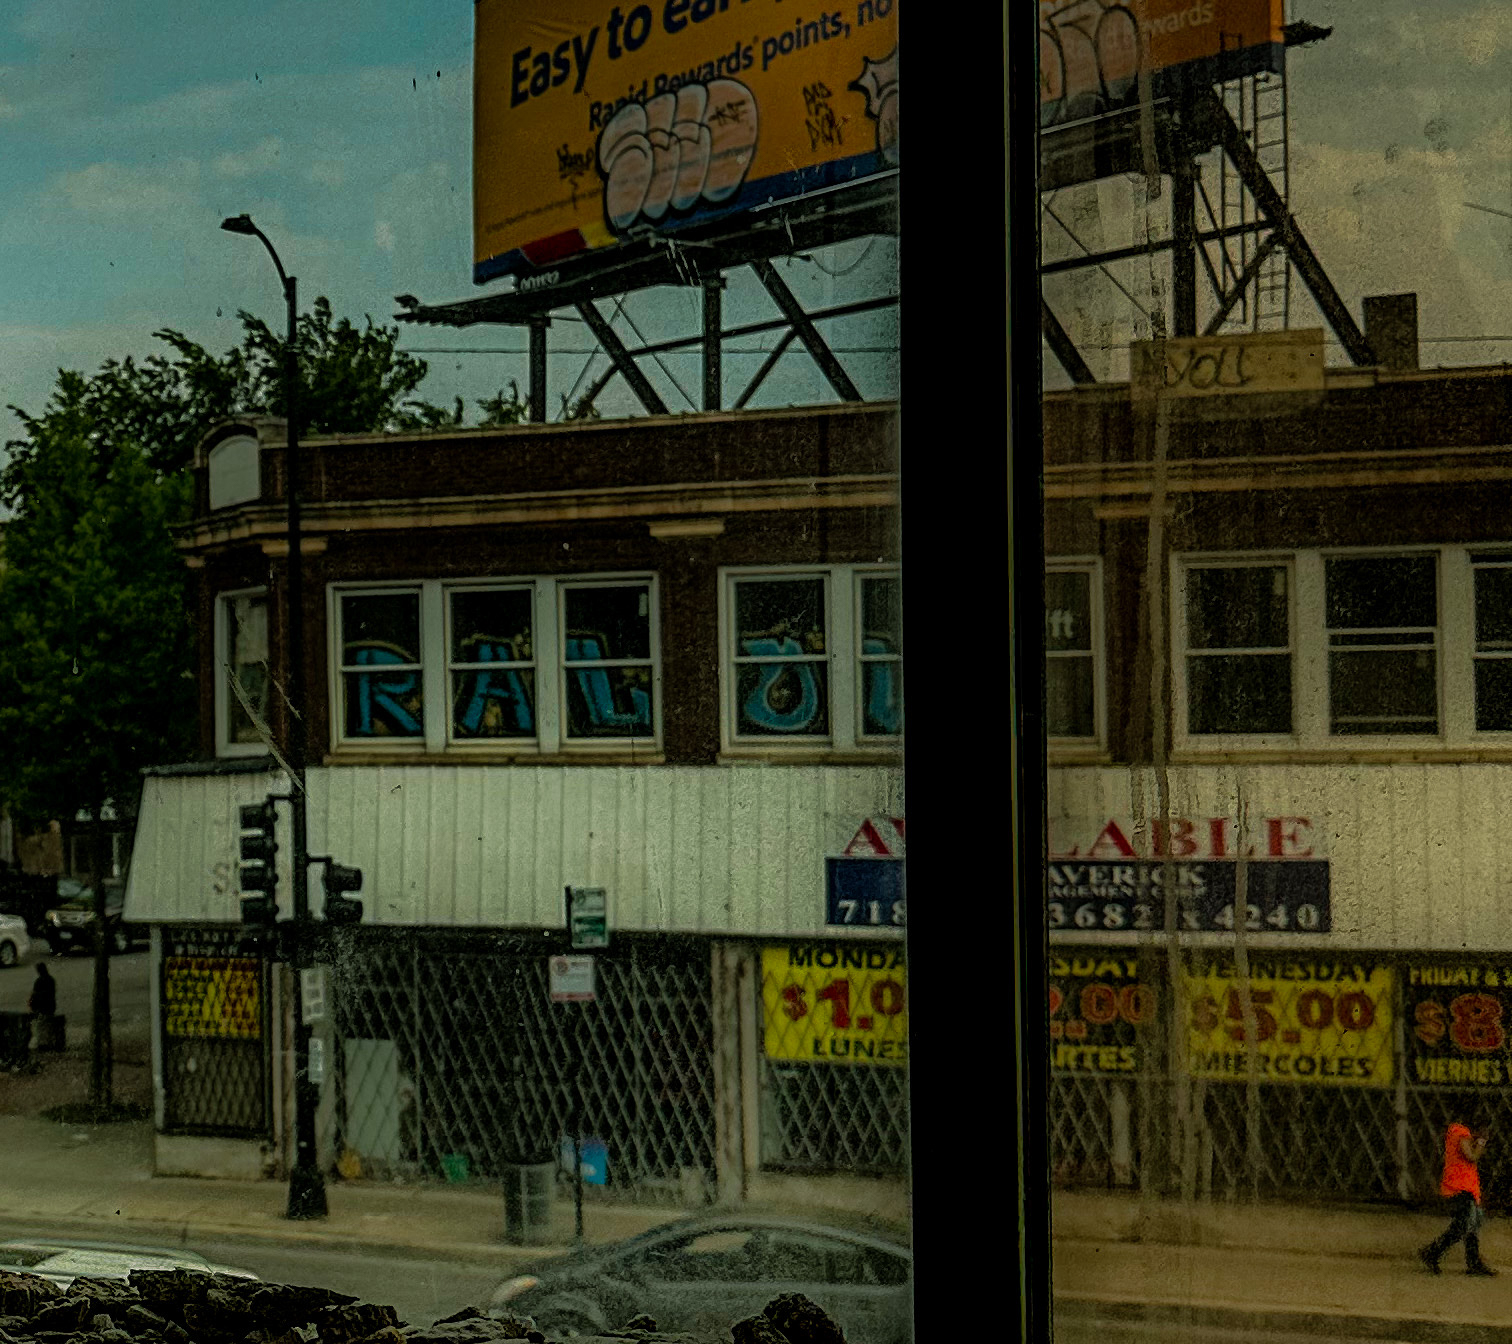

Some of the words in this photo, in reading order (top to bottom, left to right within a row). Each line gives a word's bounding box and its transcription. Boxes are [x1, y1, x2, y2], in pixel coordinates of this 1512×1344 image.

[510, 26, 600, 106] Easy
[607, 5, 652, 60] to
[761, 9, 851, 71] points,
[1048, 863, 1206, 887] VERICK
[789, 946, 907, 969] MONDA
[1185, 959, 1375, 983] WENESDAY
[1191, 989, 1374, 1044] $5.00
